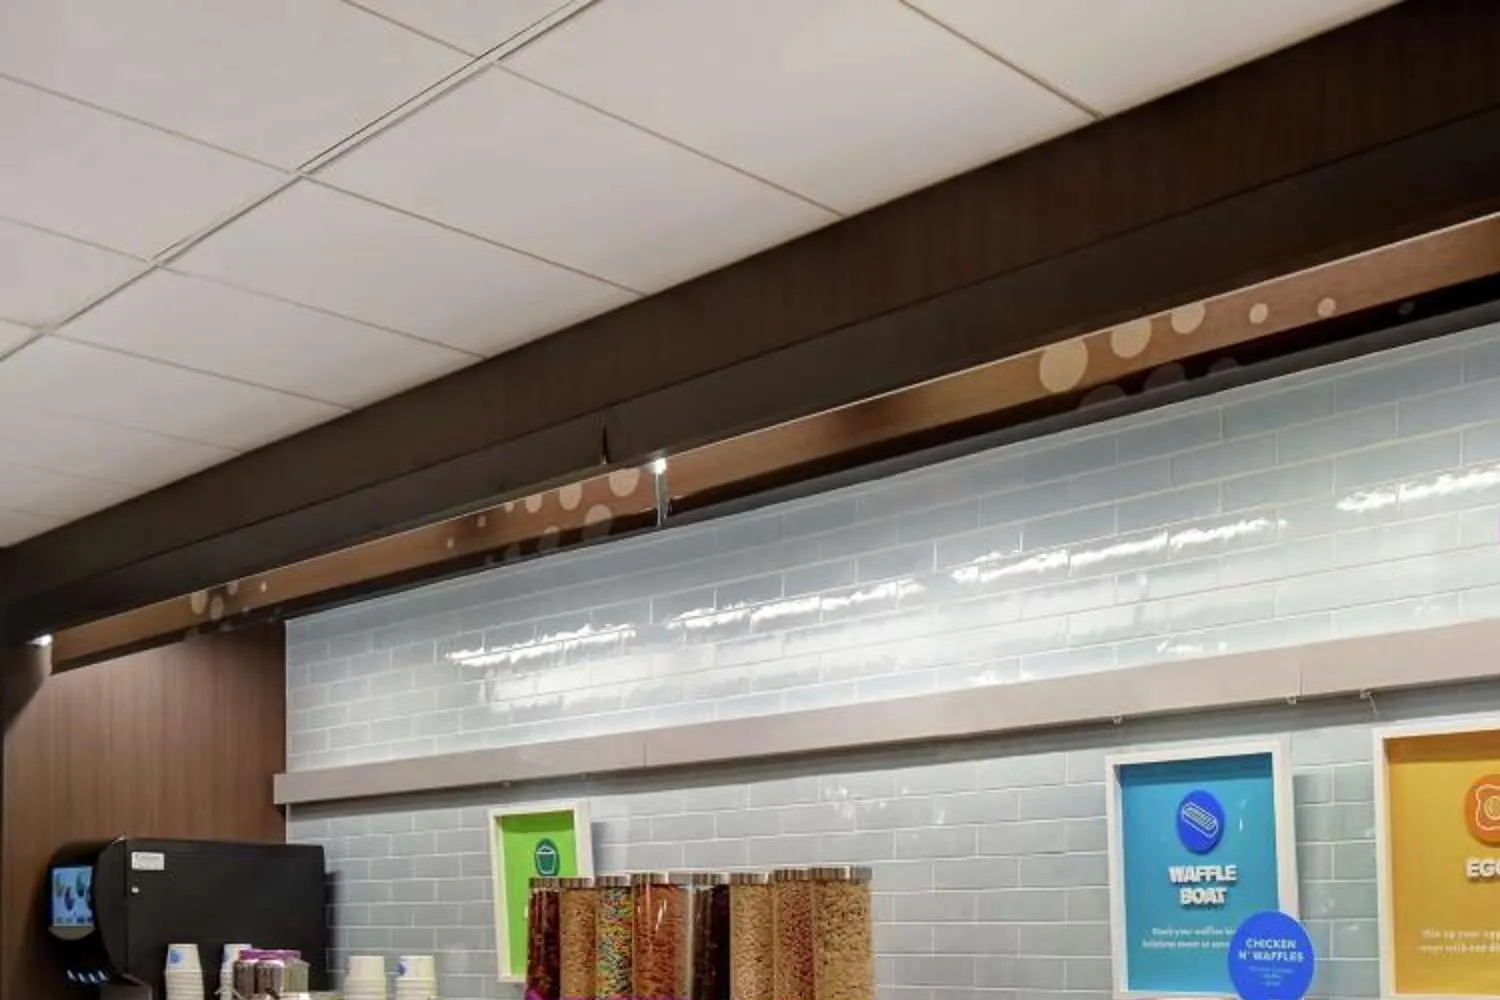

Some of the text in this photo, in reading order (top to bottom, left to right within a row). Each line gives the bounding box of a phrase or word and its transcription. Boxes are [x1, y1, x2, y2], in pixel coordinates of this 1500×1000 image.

[1168, 864, 1237, 884] WAFFLE
[1180, 887, 1228, 906] BOAT
[1246, 938, 1297, 949] CHICKEN
[1253, 951, 1305, 963] WAFFLES
